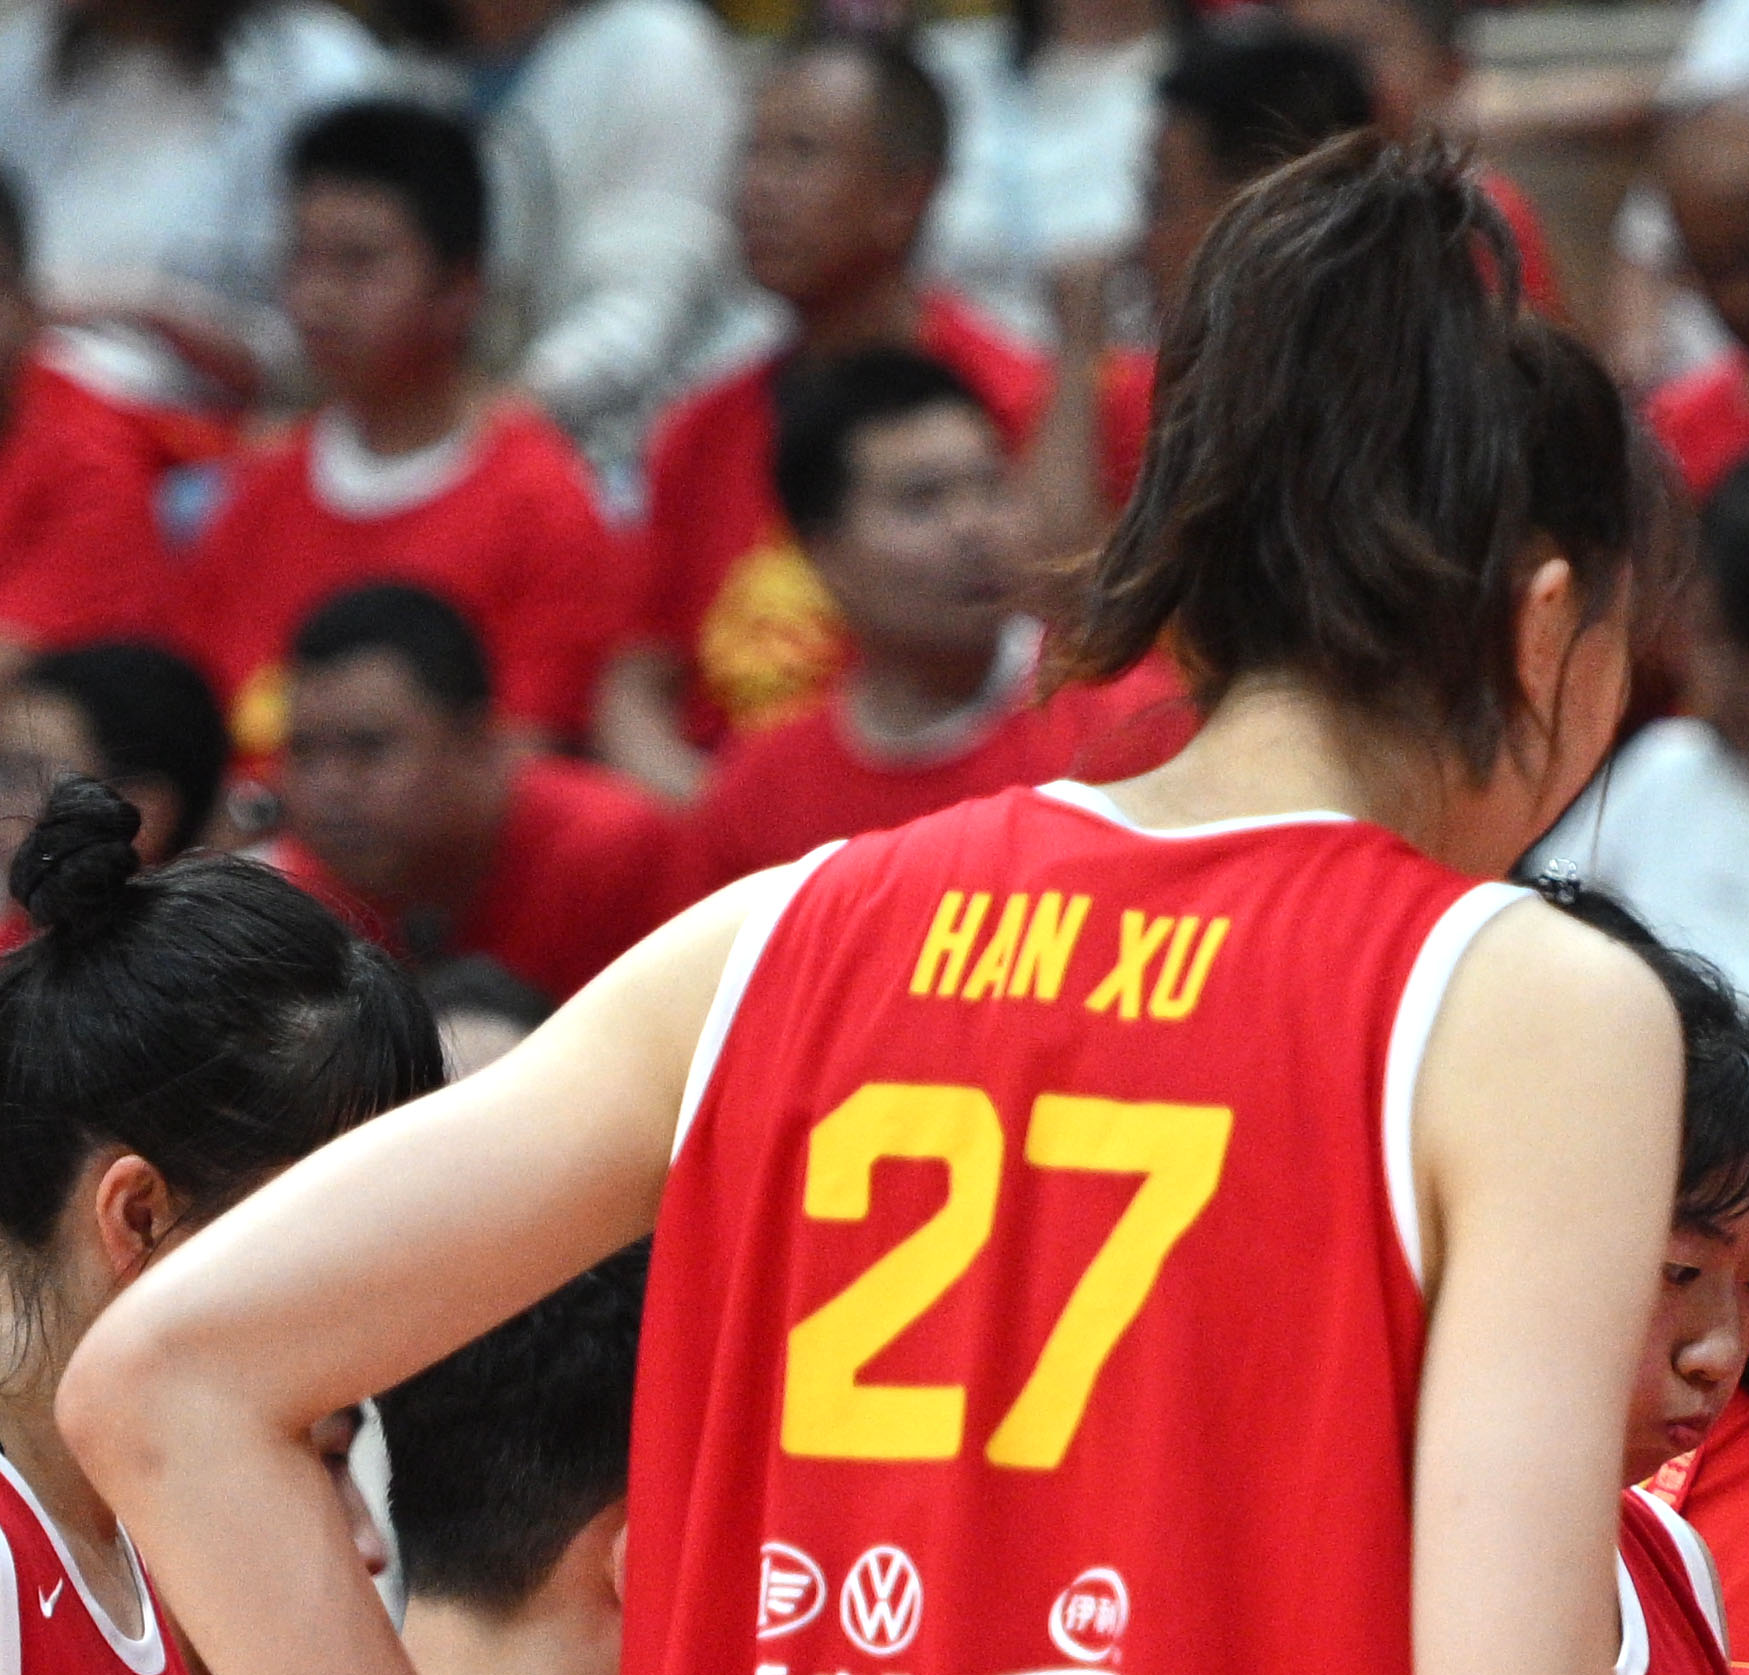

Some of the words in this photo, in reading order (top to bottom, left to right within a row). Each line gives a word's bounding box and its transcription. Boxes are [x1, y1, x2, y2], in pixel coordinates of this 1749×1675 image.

[909, 890, 1092, 1001] HAN
[1085, 909, 1230, 1021] XU
[780, 1082, 1234, 1470] 27
